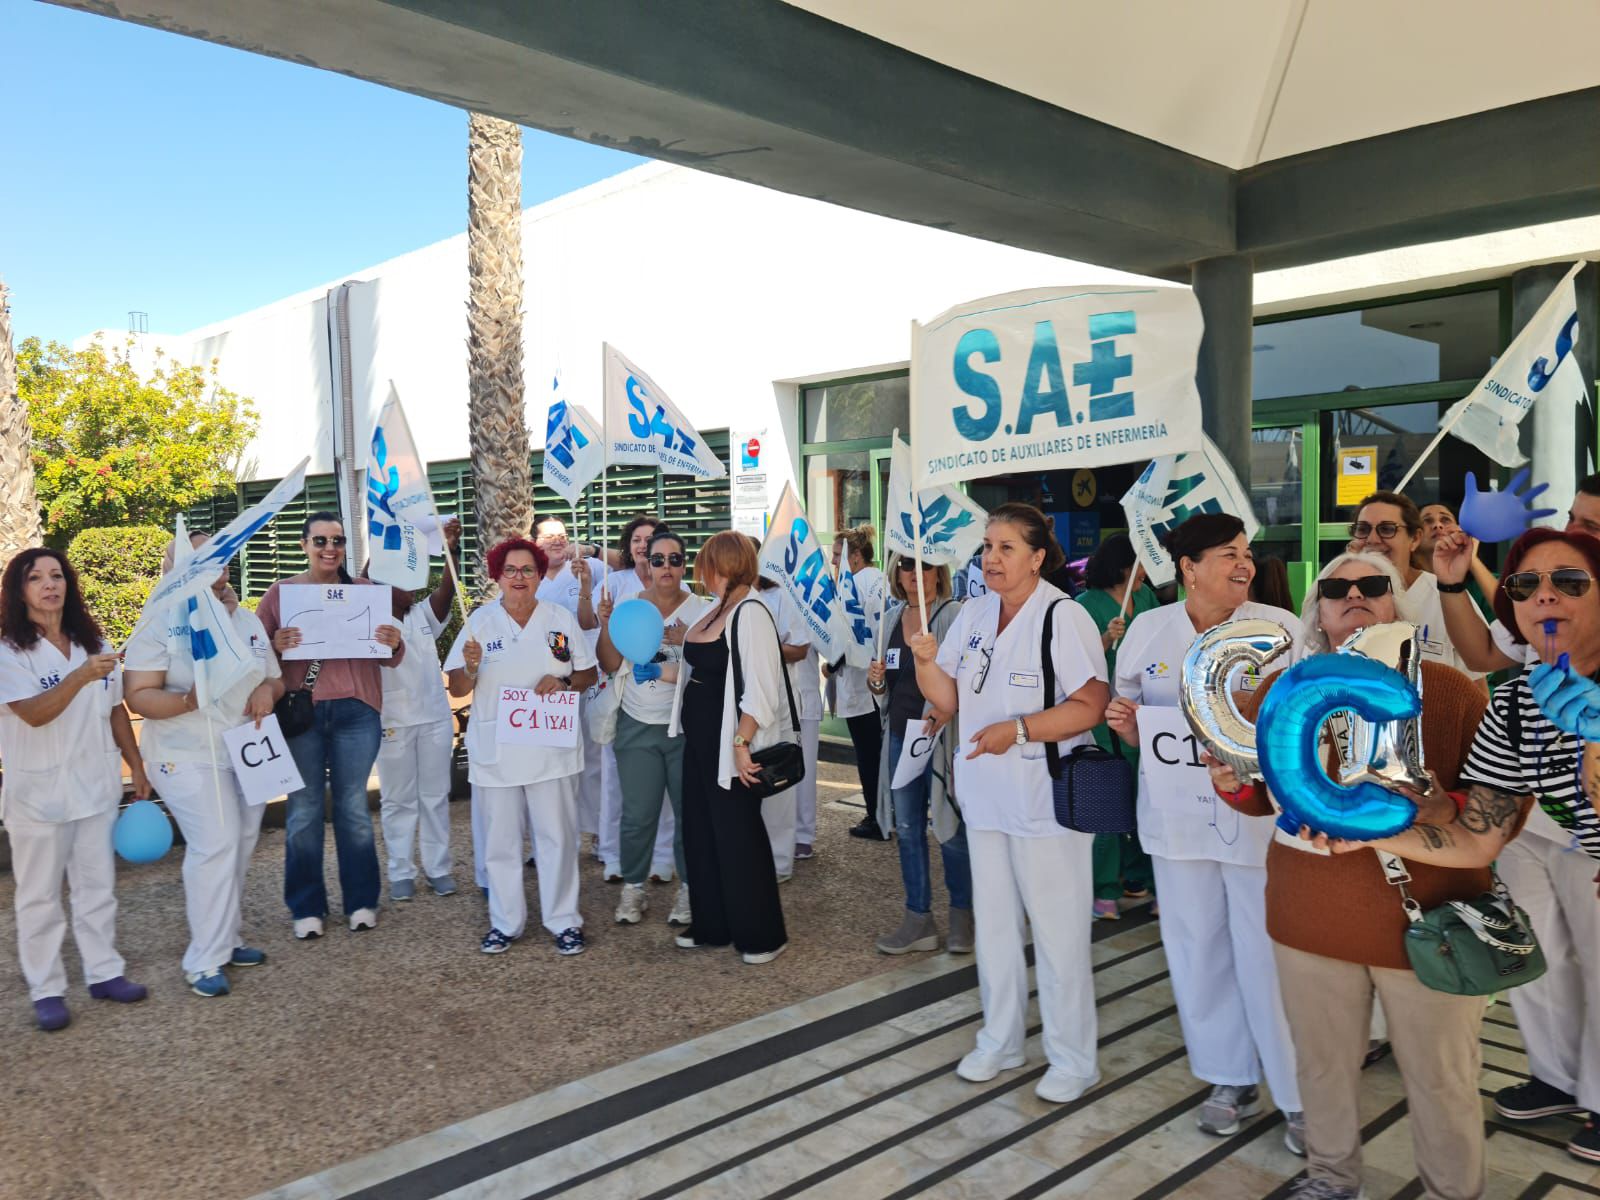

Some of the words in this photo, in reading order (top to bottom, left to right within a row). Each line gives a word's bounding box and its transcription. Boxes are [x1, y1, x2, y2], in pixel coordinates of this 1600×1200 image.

[614, 443, 647, 453] SINDICATO
[648, 443, 656, 453] DE
[928, 453, 989, 474] SINDICATO
[992, 448, 1007, 463] DE
[1010, 438, 1074, 460] AUXILIARES
[1077, 435, 1093, 450] DE
[1095, 418, 1169, 447] ENFERMERÍA
[890, 529, 915, 551] SINDICAT
[502, 689, 528, 702] SOY
[509, 708, 540, 728] C1
[240, 735, 281, 768] C1
[1152, 731, 1207, 768] C1
